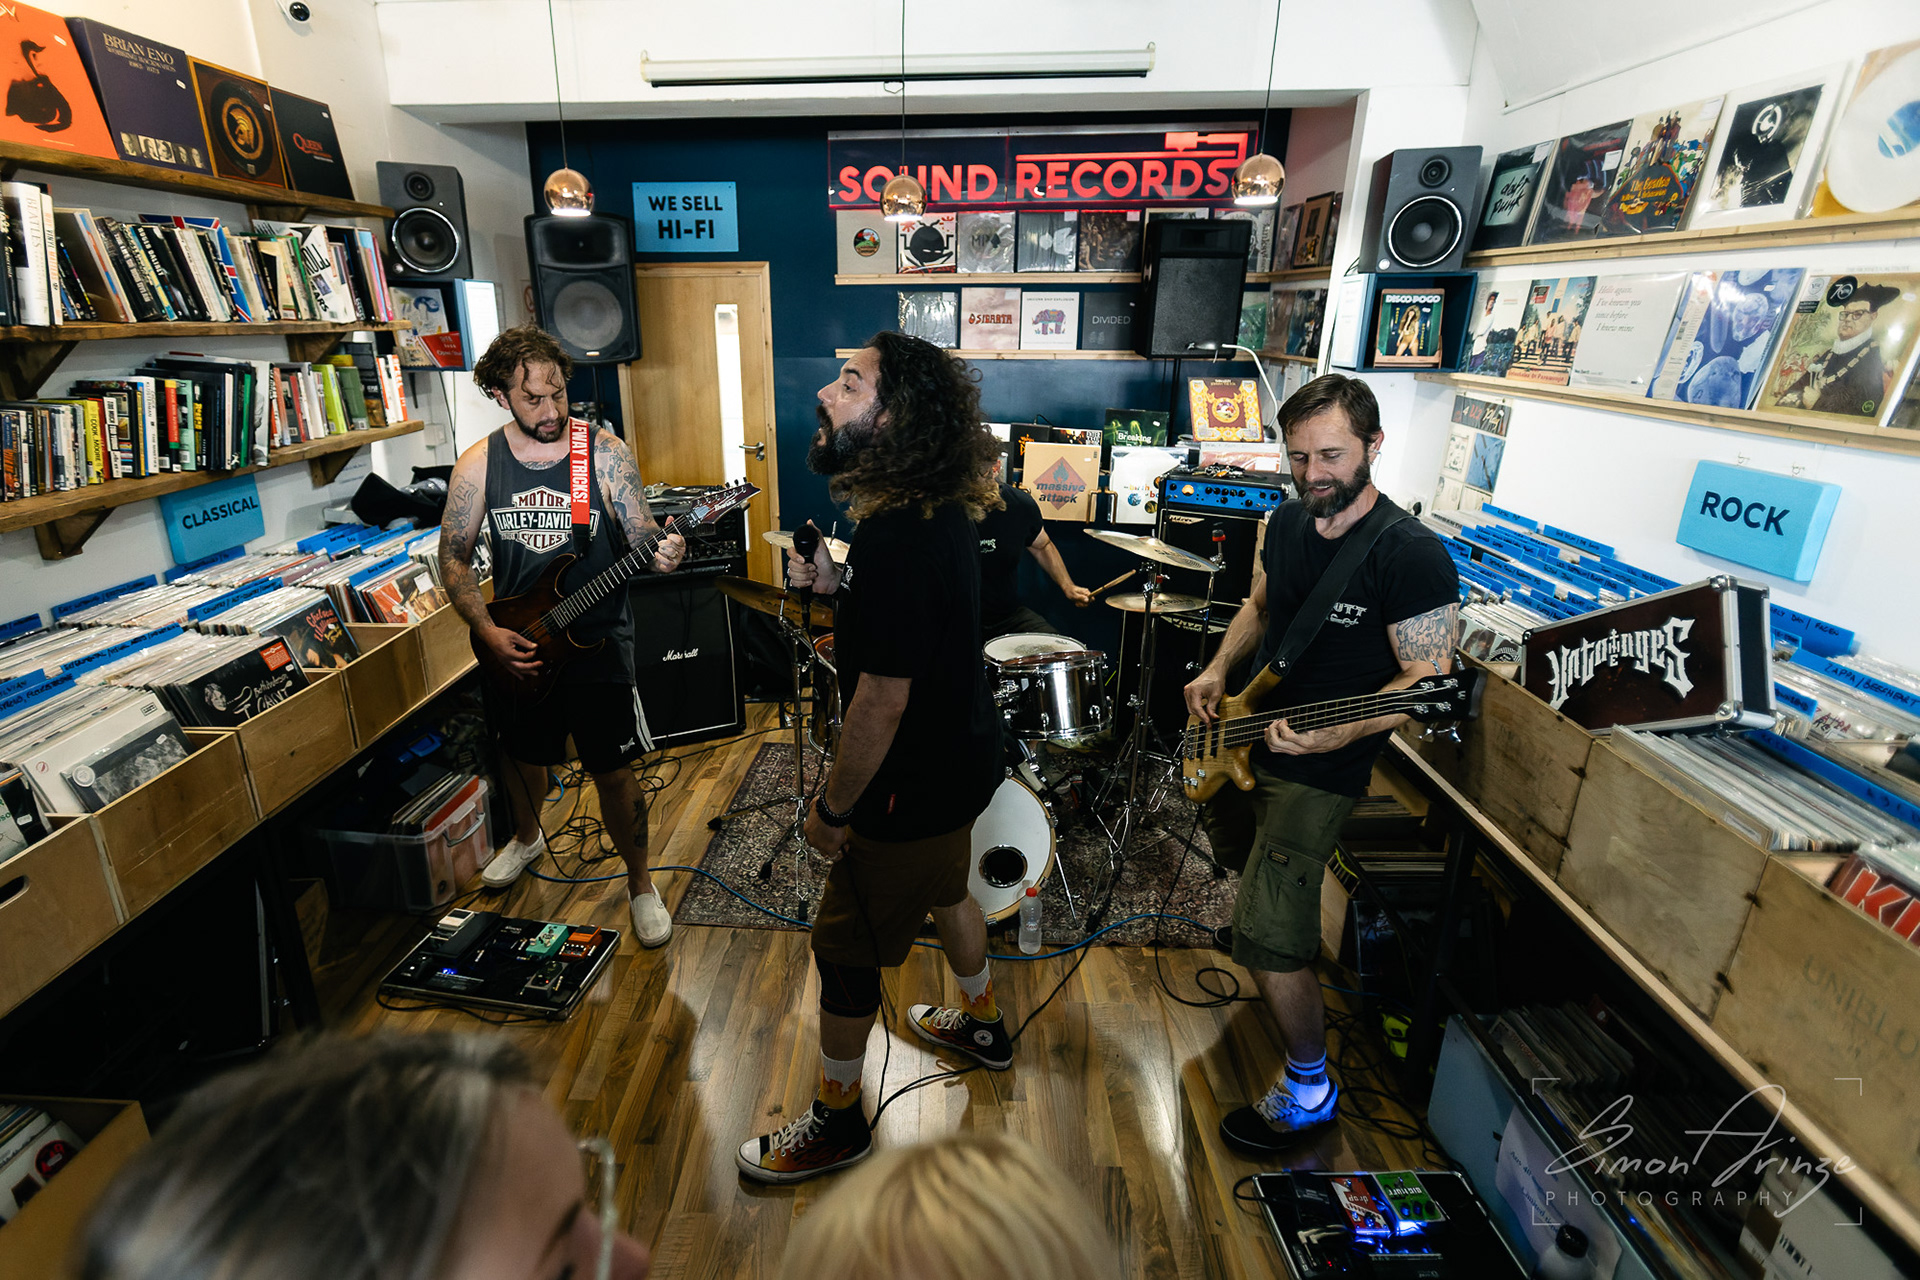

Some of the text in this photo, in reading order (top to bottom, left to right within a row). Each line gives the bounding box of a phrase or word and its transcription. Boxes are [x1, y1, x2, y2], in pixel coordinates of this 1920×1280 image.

[102, 33, 174, 66] BRIAN ENO
[1016, 157, 1238, 200] RECORDS
[1501, 175, 1530, 198] daft
[1643, 176, 1671, 190] Beatles
[648, 196, 723, 211] WE SELL
[1489, 190, 1526, 221] punk
[25, 196, 42, 248] BEATLES
[657, 219, 715, 239] HI-FI
[45, 228, 55, 248] VINYL
[136, 226, 152, 249] ROGER
[1385, 295, 1441, 303] DISCO POGO
[1091, 315, 1131, 325] DIVIDED
[1118, 433, 1152, 444] Breaking
[571, 418, 588, 503] LFWAY TRICKS!
[1036, 482, 1085, 493] massive
[518, 490, 565, 507] MOTOR
[1038, 492, 1078, 504] attack
[182, 496, 258, 530] CLASSICAL
[1700, 491, 1790, 536] ROCK
[521, 532, 563, 549] CYCLES
[1823, 660, 1857, 684] ZAPPA
